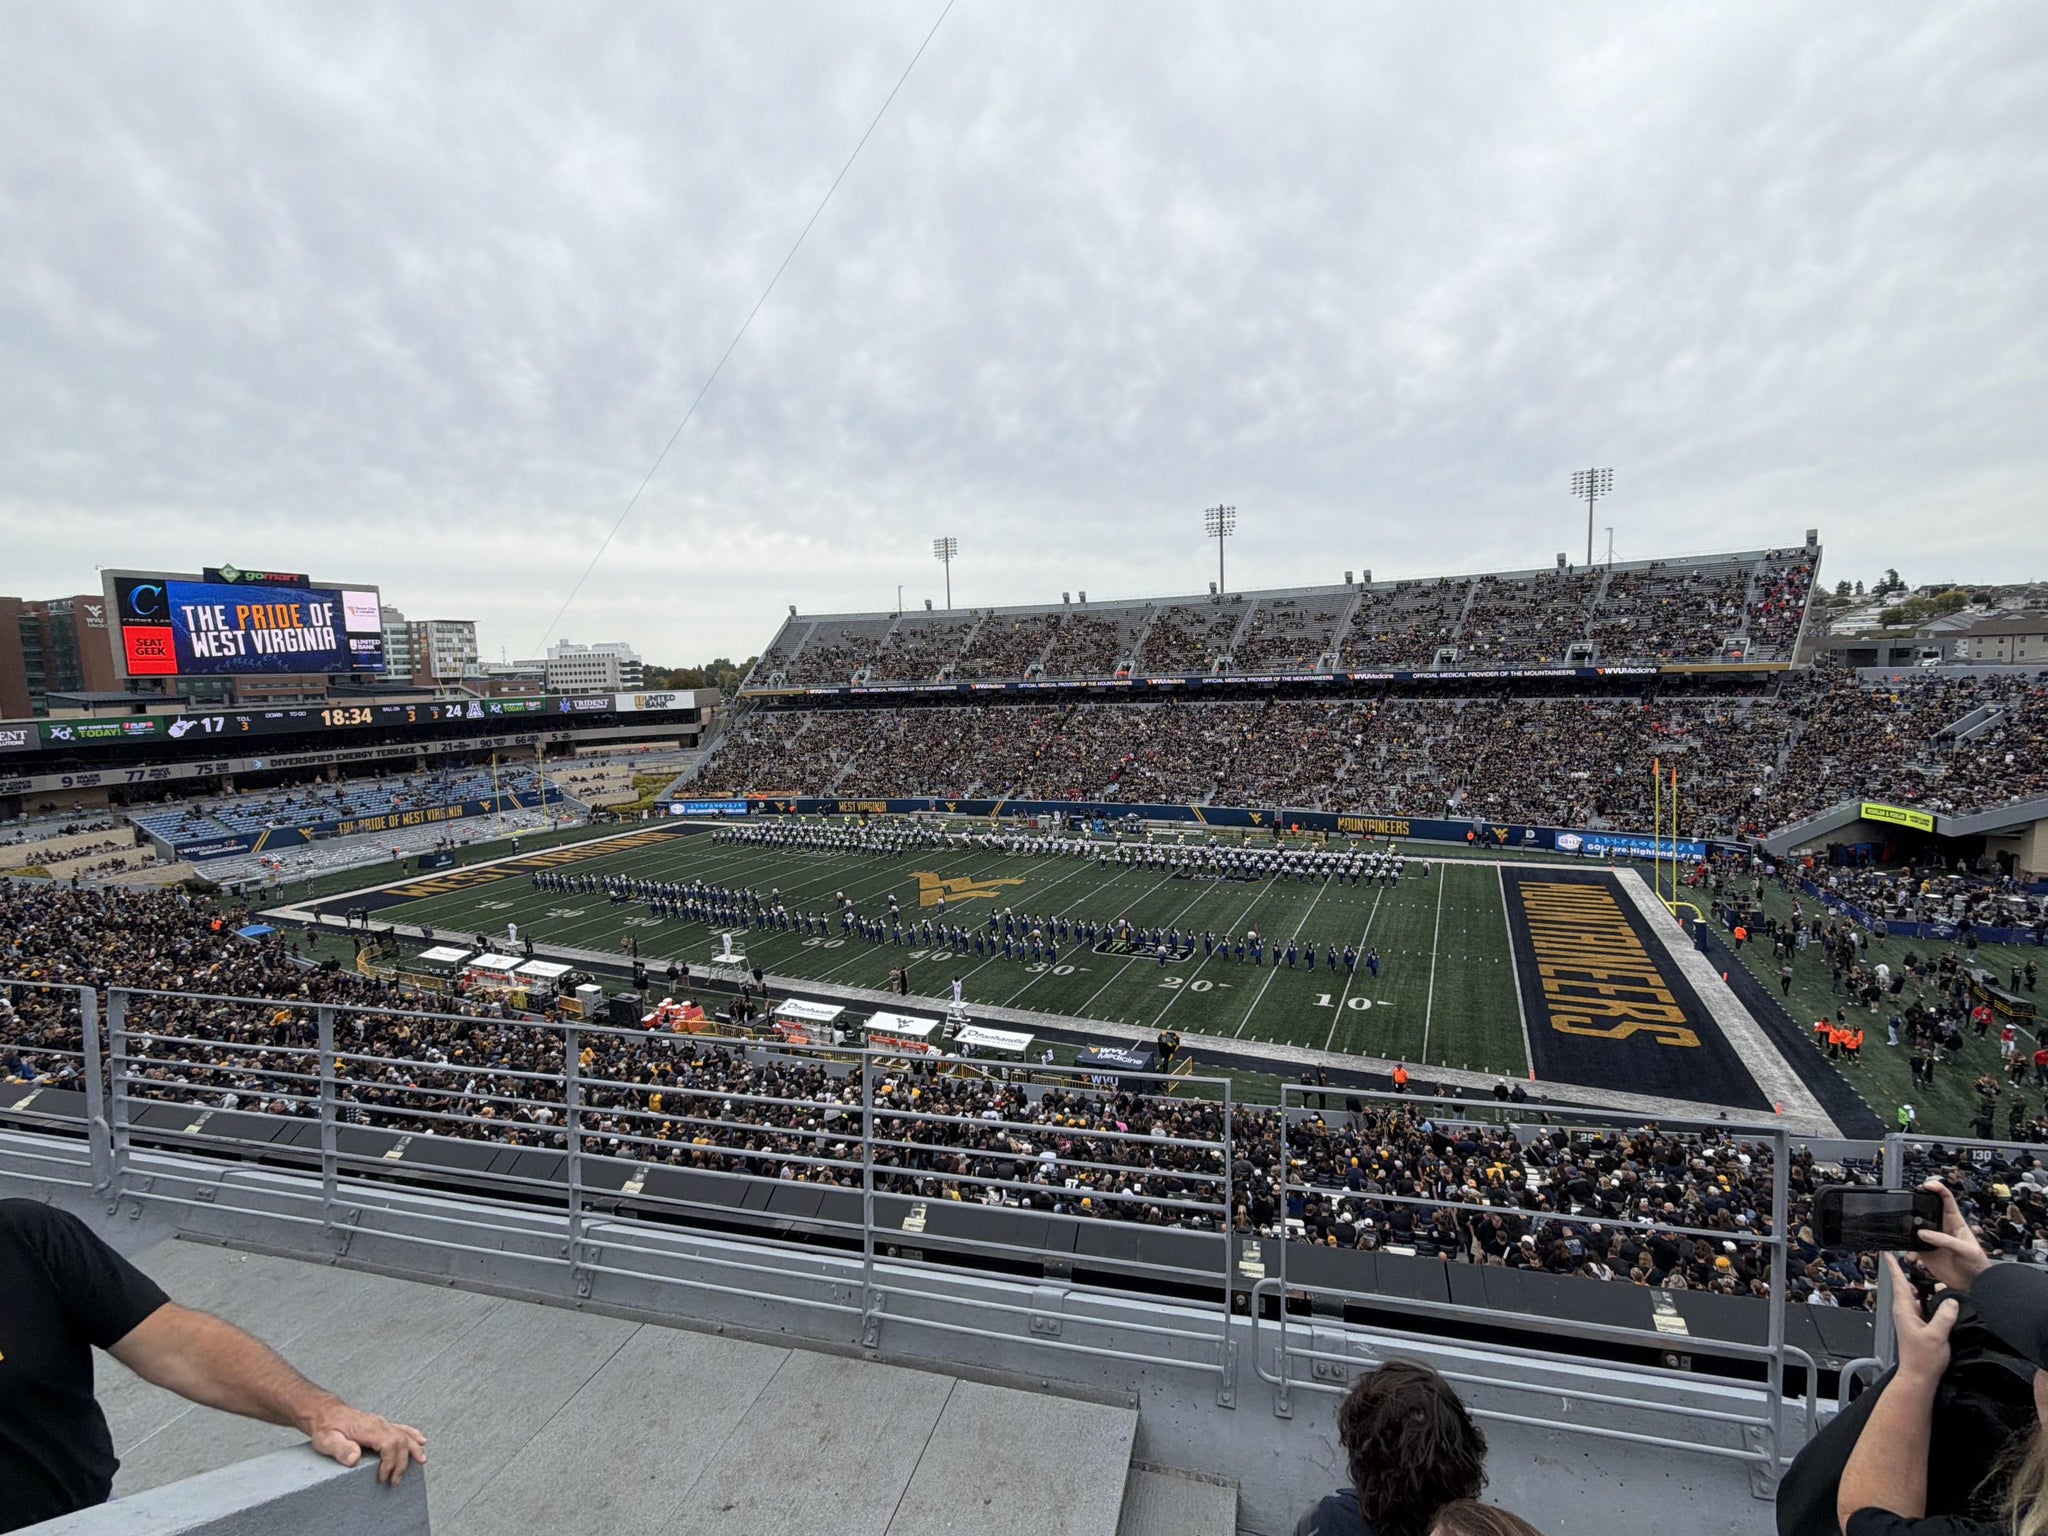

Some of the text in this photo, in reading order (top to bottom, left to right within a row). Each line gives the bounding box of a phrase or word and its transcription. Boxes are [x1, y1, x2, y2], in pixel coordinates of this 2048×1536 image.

[181, 603, 333, 631] THE PRIDE OF
[136, 638, 164, 646] SEAT
[190, 627, 336, 658] WEST VIRGINIA
[136, 648, 166, 656] GEEK
[1604, 667, 1657, 675] WVUMedicine
[572, 699, 609, 707] TRIDENT
[445, 704, 462, 718] 24
[466, 701, 484, 718] A
[320, 708, 373, 726] 18:34
[408, 711, 416, 722] 3
[201, 717, 225, 732] 17
[242, 721, 249, 731] 3
[78, 729, 120, 738] TODAY!
[441, 743, 452, 751] 21
[480, 740, 492, 748] 90
[270, 746, 416, 767] DIVERSIFIED ENERGY TERRACE
[194, 764, 213, 775] 75
[61, 776, 73, 787] 9
[124, 770, 146, 782] 77
[838, 800, 887, 813] WEST VIRGINIA
[358, 816, 385, 831] PRIDE
[389, 814, 400, 826] OF
[402, 812, 424, 826] WEST
[1337, 817, 1410, 835] MOUNTAINEERS
[382, 832, 684, 897] WEST VIRGINIA
[801, 937, 845, 949] 50
[907, 950, 953, 962] 40
[1024, 962, 1076, 976] 30
[1518, 881, 1702, 1048] MOUNTAINEERS
[1157, 976, 1214, 992] 20
[1312, 993, 1372, 1010] 10
[976, 1033, 1026, 1044] Panhandle
[1099, 1048, 1128, 1056] WVU
[1097, 1053, 1143, 1065] Medicine
[1091, 1075, 1119, 1087] WVU
[1972, 1150, 1992, 1160] 130
